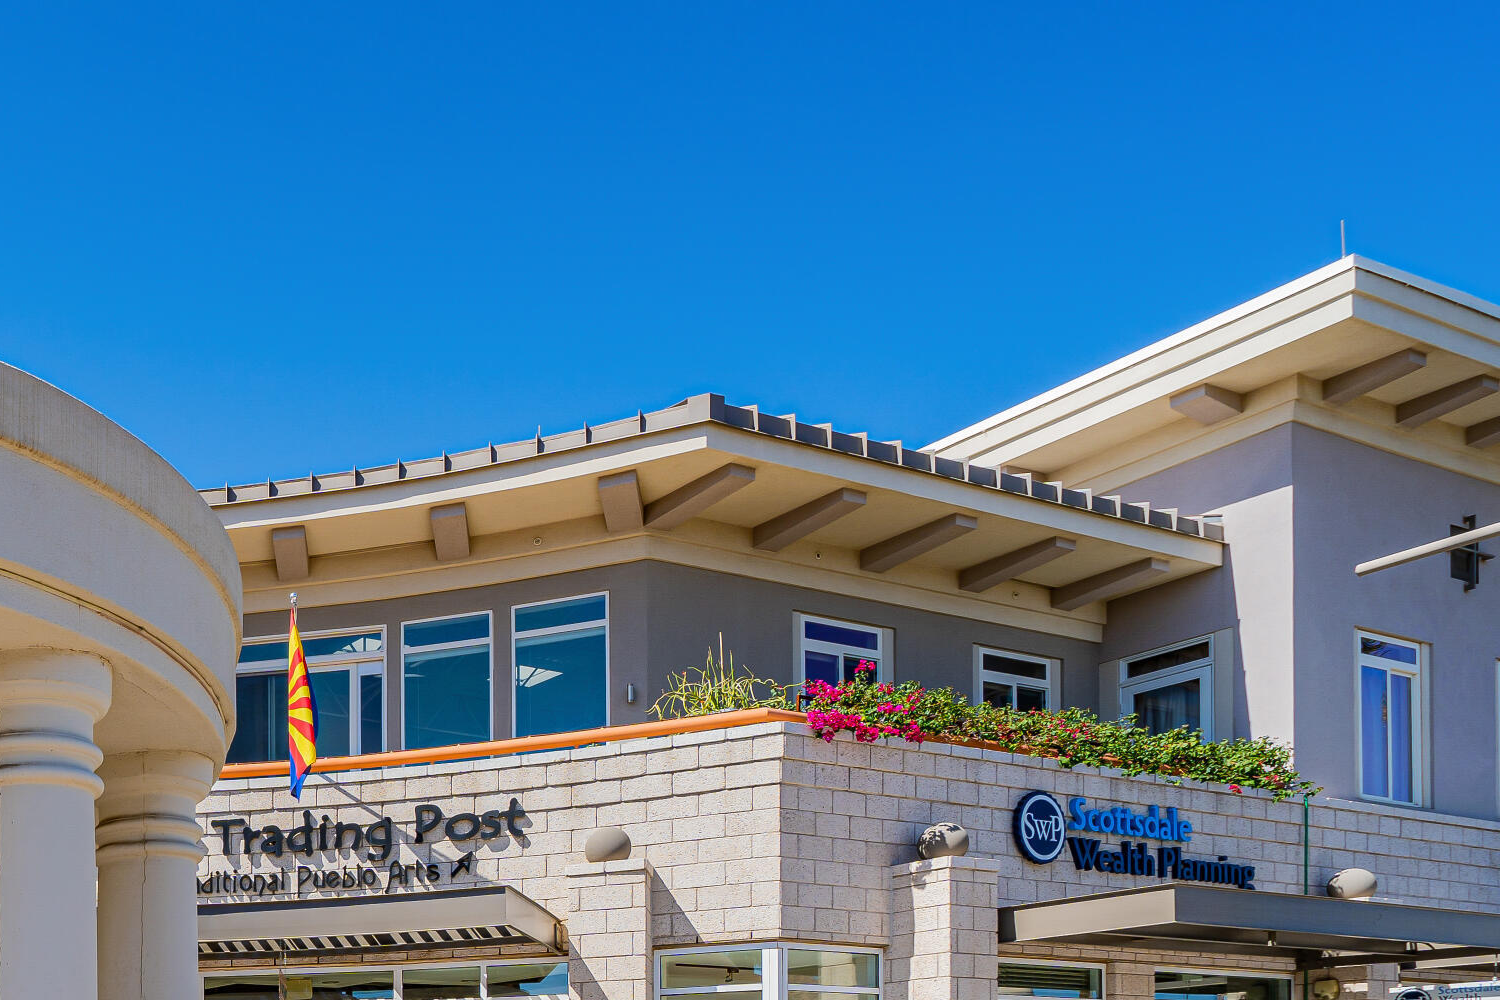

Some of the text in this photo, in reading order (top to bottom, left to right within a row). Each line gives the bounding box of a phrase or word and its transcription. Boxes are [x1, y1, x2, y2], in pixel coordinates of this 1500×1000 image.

[211, 797, 527, 861] Trading Post
[1067, 797, 1193, 842] Scottsdale
[297, 863, 377, 898] Pueblo
[385, 859, 440, 894] Arts
[1066, 836, 1256, 890] Wealth Planning
[1438, 985, 1500, 994] Scottsdale
